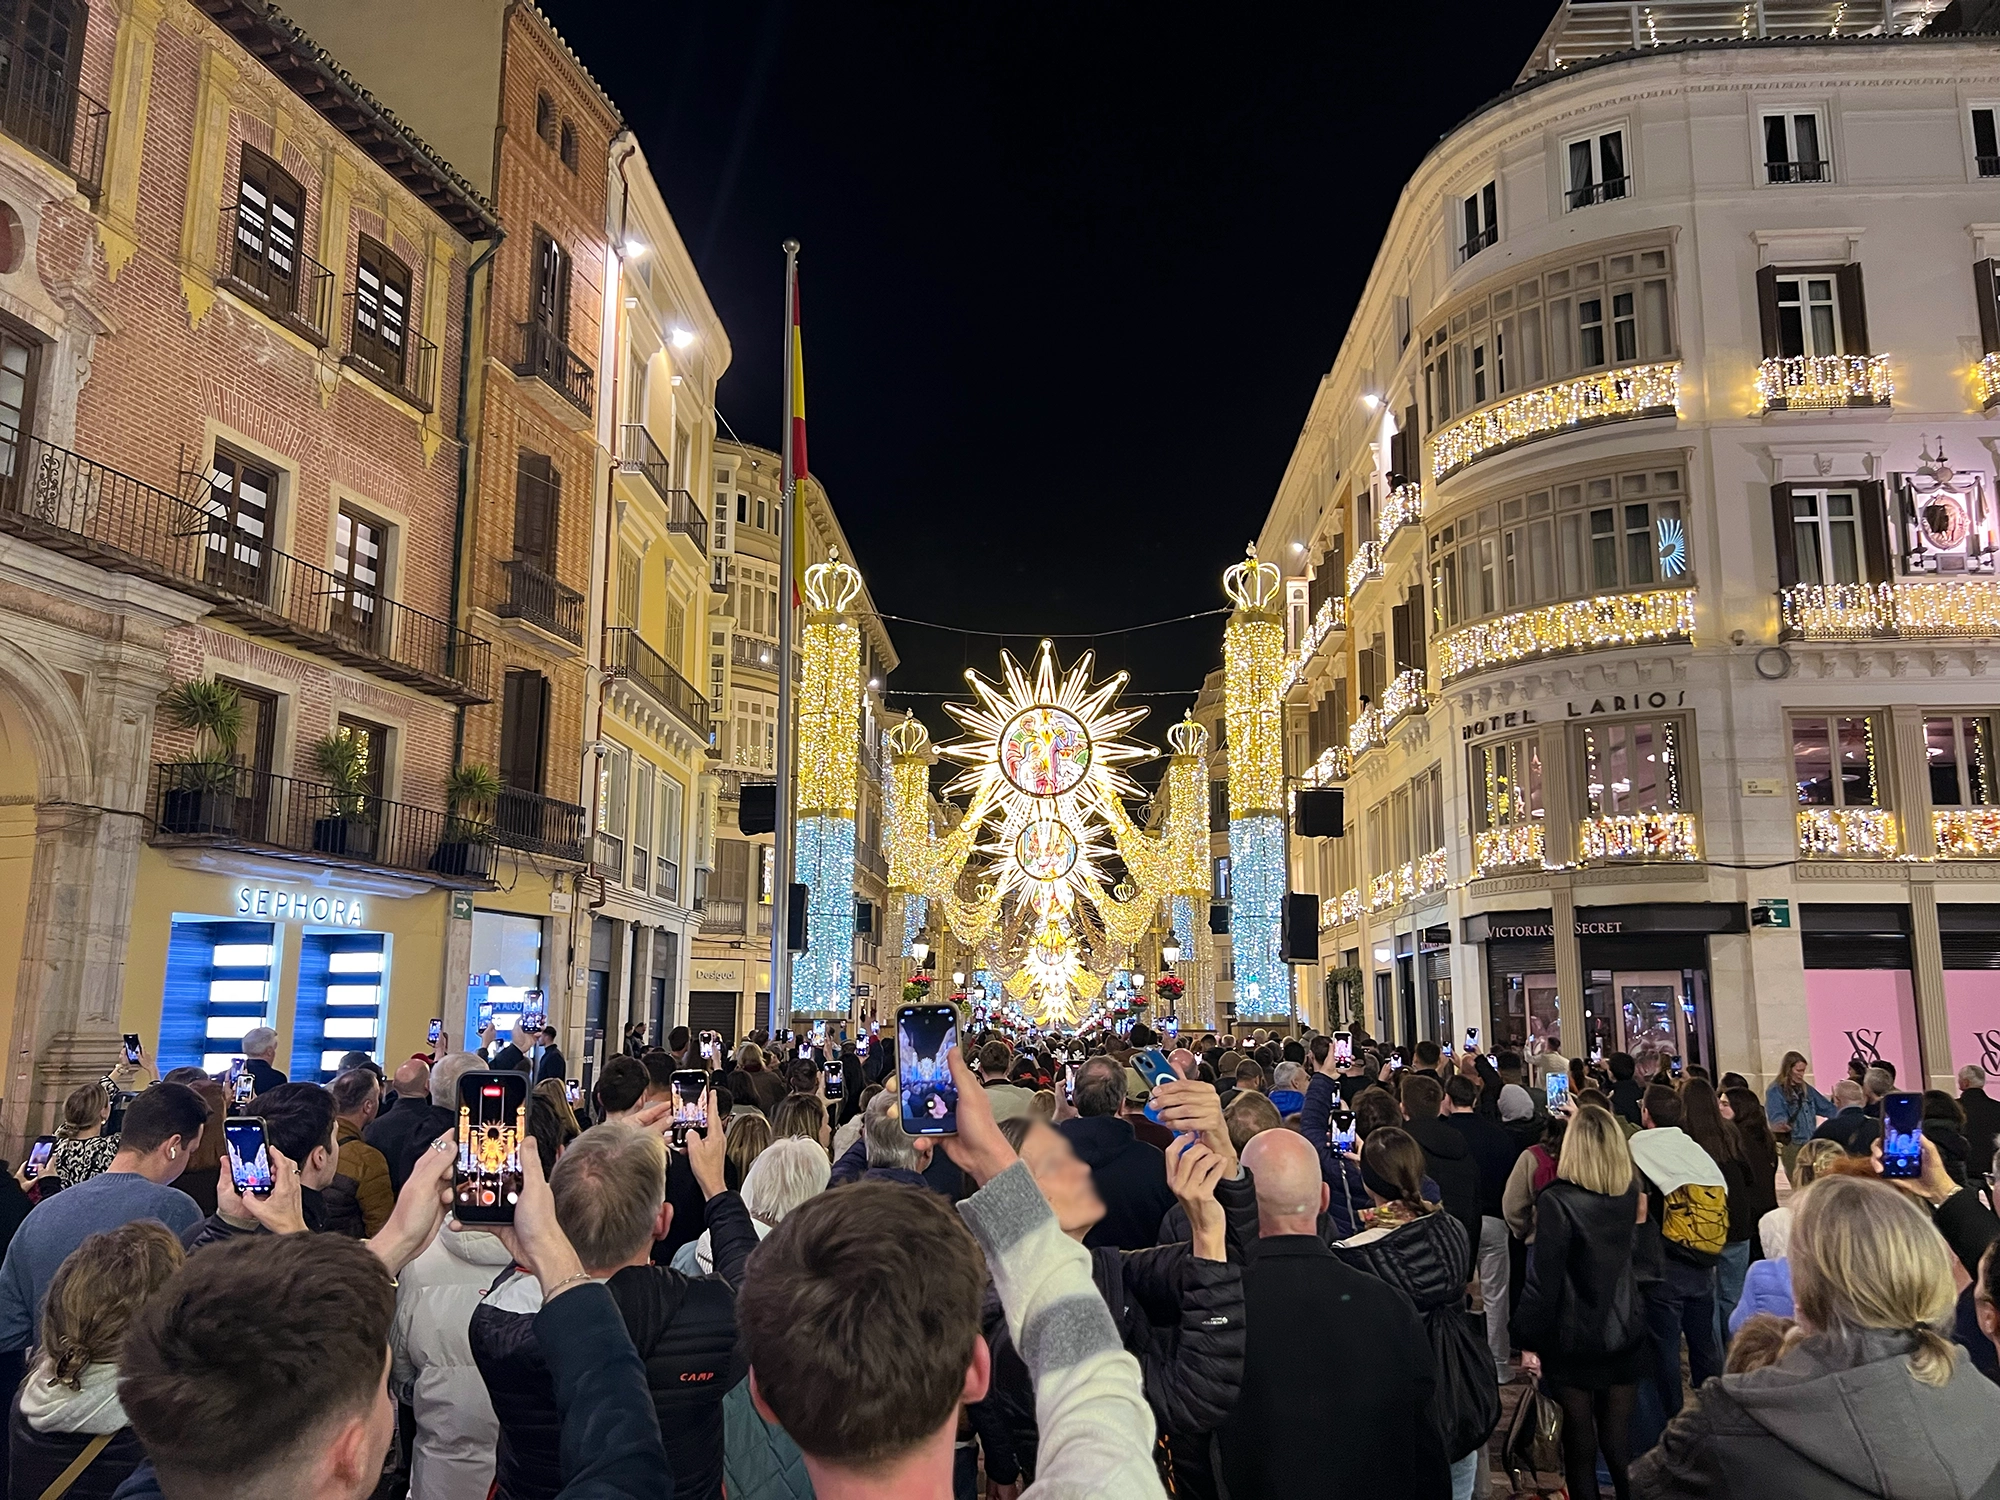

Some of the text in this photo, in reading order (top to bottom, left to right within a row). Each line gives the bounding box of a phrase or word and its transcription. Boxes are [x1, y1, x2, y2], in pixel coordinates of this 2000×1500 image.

[1462, 690, 1686, 740] HOTEL LARIOS
[237, 886, 363, 927] SEPHORA
[1487, 921, 1622, 938] VICTORIA'S SECRET
[695, 969, 736, 982] Desigual
[679, 1372, 714, 1382] CAMP
